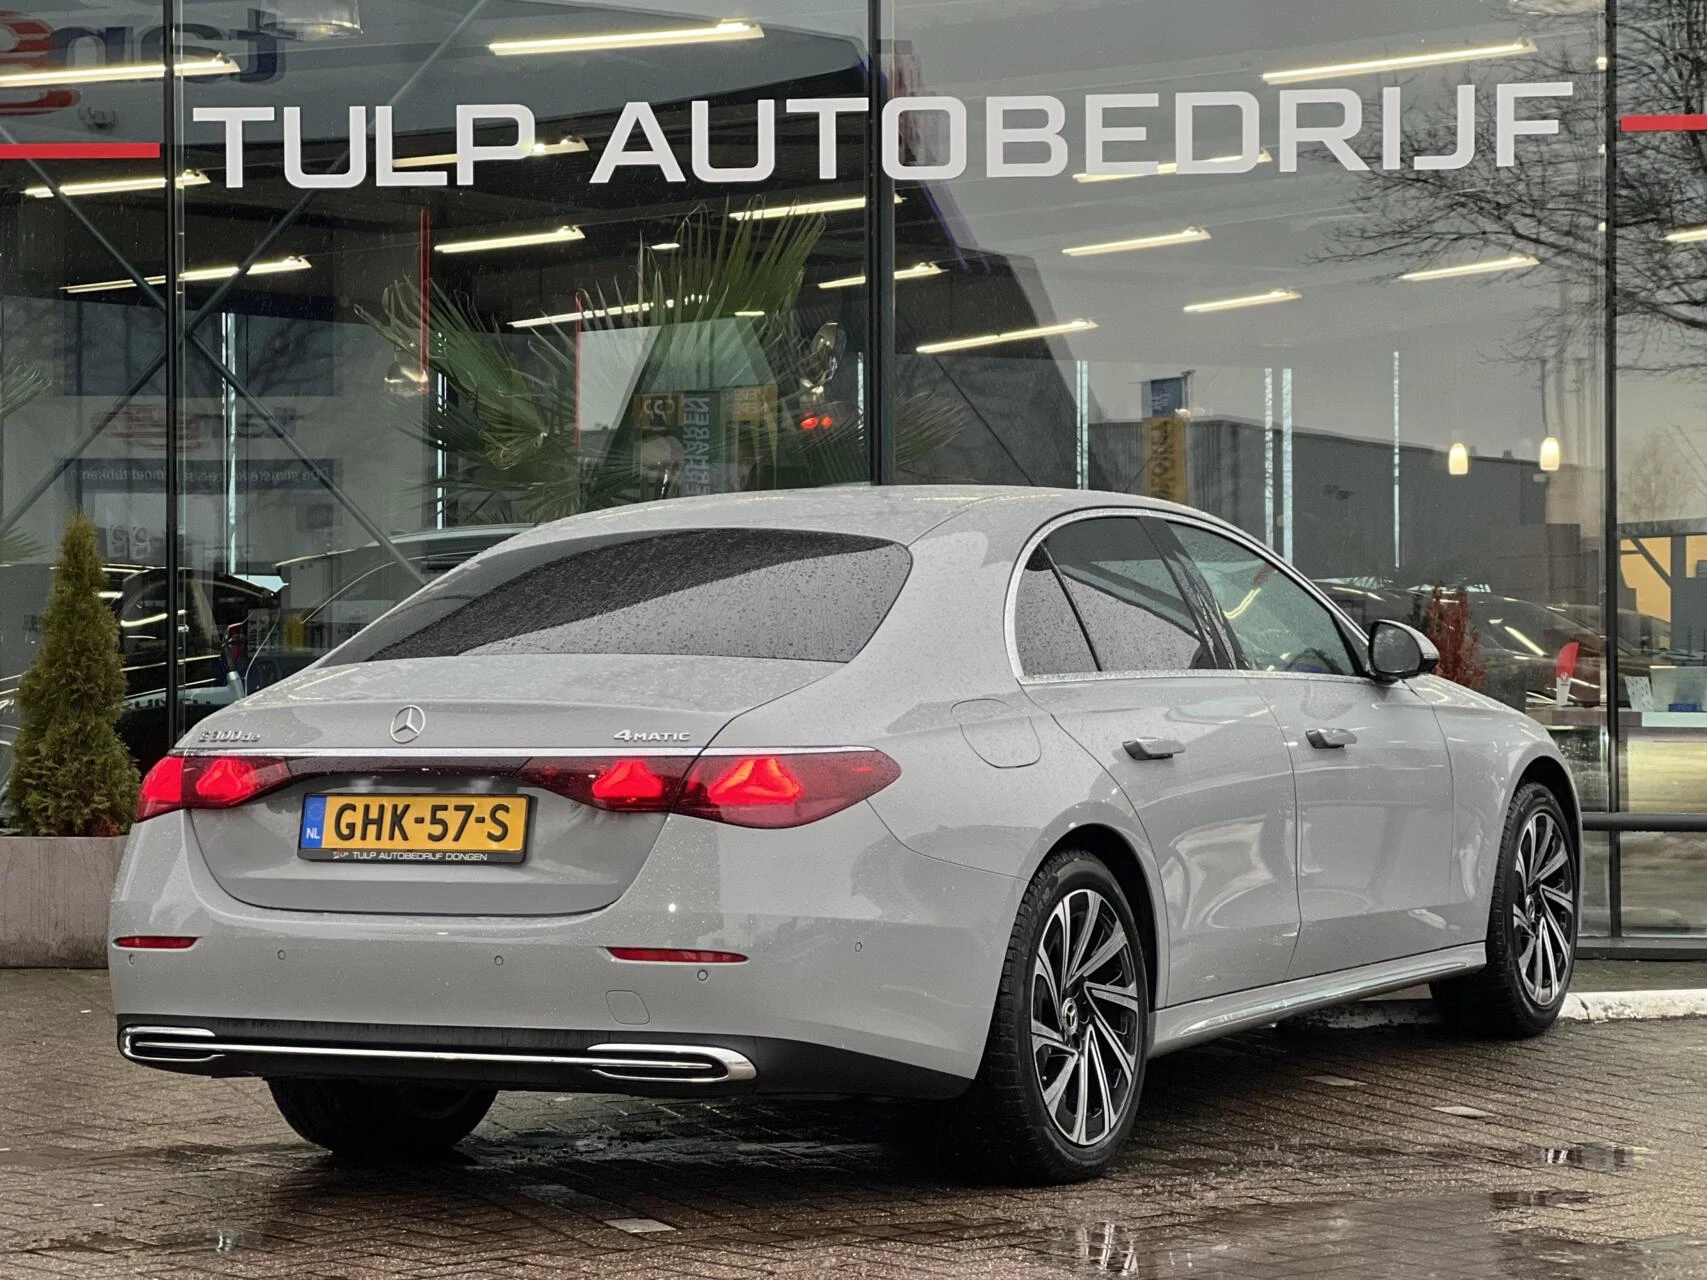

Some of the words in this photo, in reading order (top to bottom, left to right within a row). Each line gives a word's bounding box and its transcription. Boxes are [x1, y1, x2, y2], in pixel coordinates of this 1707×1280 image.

[193, 103, 536, 189] TULP
[588, 82, 1574, 185] AUTOBEDRIJF
[613, 729, 690, 741] 4MATIC
[334, 803, 510, 842] GHK-57-S
[306, 828, 320, 839] NL
[353, 851, 376, 859] TULP
[378, 851, 442, 860] AUTOBEDRIJF
[445, 852, 488, 861] DONGEN
